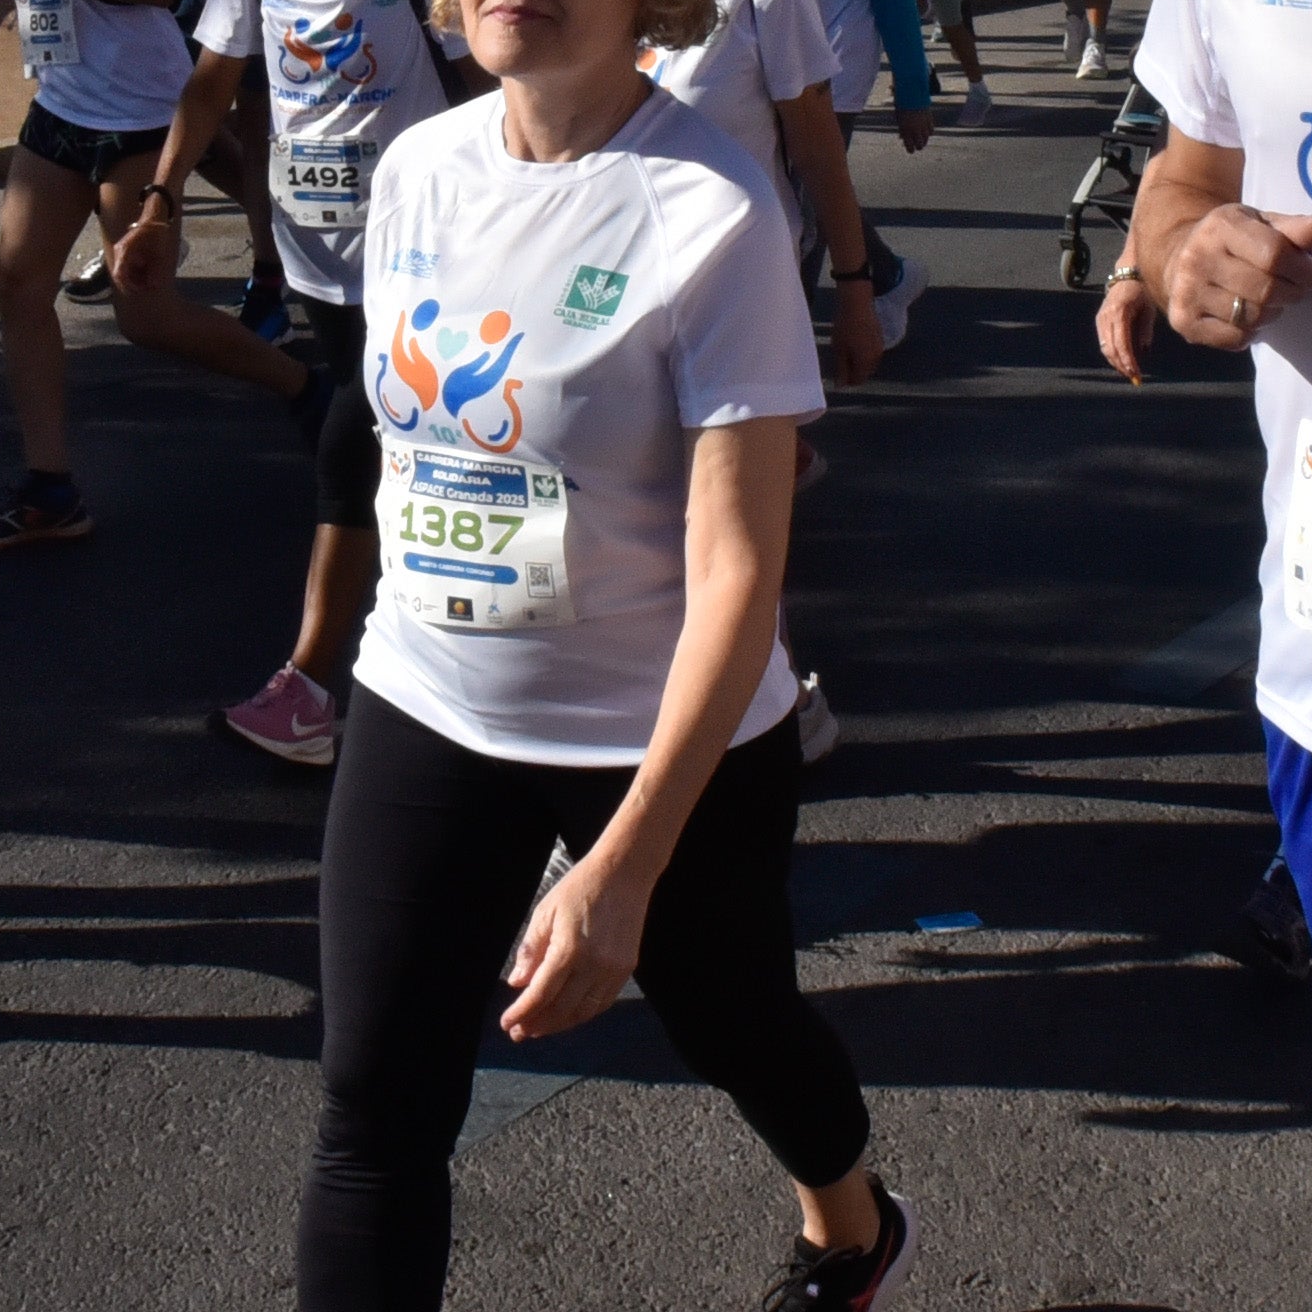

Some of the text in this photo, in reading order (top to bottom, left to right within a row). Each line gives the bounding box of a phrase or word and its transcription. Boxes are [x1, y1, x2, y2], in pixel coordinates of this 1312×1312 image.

[30, 13, 59, 31] 802
[288, 165, 359, 187] 1492
[432, 469, 492, 486] SOLIDARIA
[411, 481, 445, 497] ASPACE
[446, 485, 494, 504] Granada
[496, 492, 526, 506] 2025
[400, 501, 525, 555] 1387
